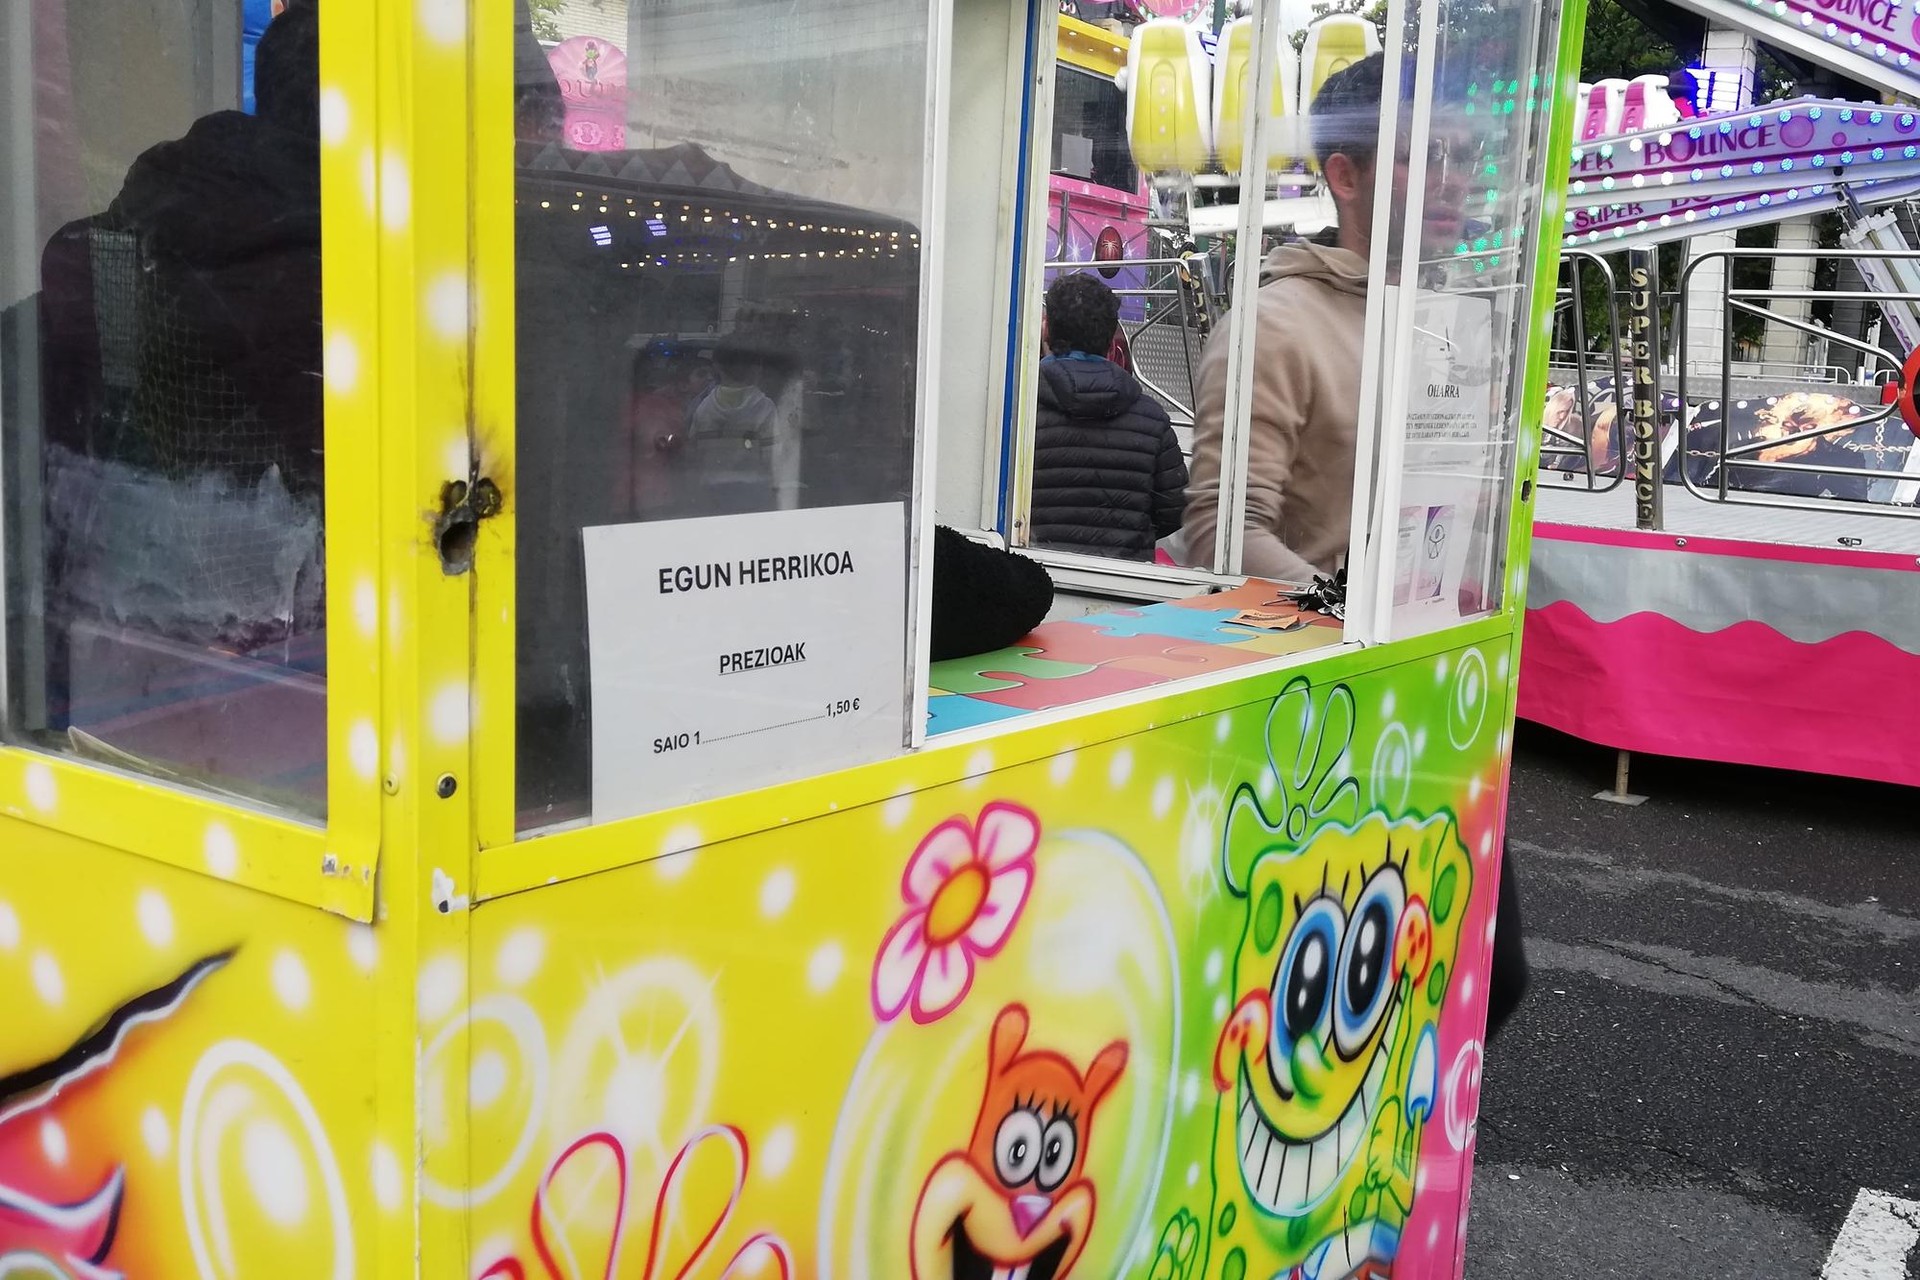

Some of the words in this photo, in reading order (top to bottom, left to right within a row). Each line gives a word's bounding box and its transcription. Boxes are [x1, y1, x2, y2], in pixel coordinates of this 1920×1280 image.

[1643, 123, 1777, 166] BOUNCE
[1630, 268, 1654, 385] SUPER
[1634, 399, 1655, 521] BOUNCE
[659, 562, 731, 594] EGUN
[739, 551, 854, 586] HERRIKOA
[719, 642, 806, 675] PREZIOAK
[653, 733, 689, 754] SAIO
[825, 699, 851, 718] 1,50
[852, 697, 860, 711] €
